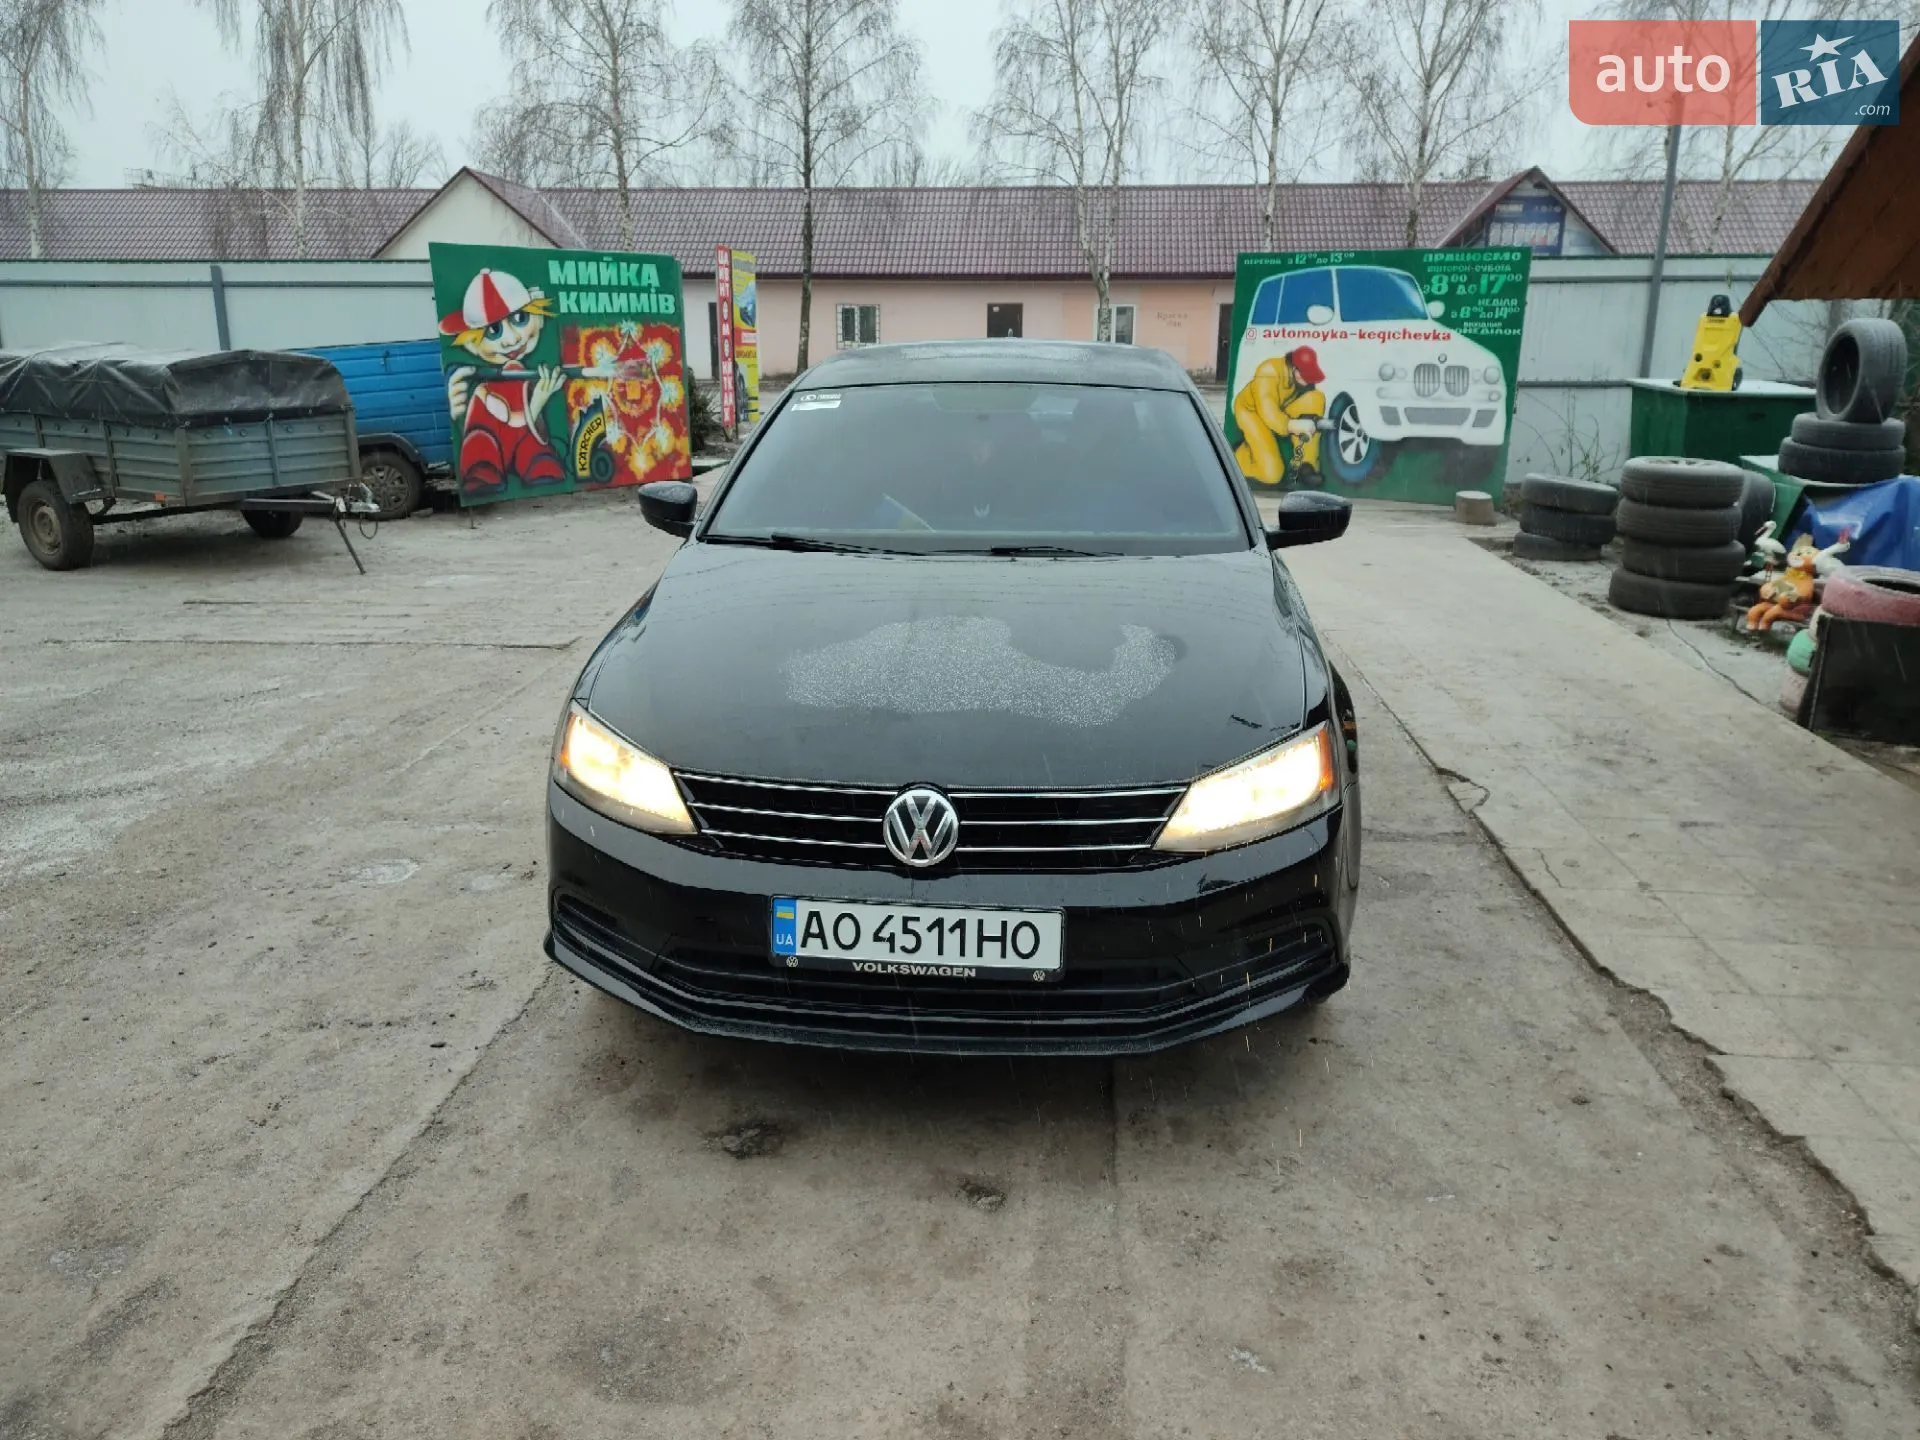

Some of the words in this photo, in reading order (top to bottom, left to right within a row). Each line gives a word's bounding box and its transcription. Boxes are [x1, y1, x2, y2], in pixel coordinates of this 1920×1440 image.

[1423, 252, 1522, 263] ПРАЦЮЄМО
[548, 256, 660, 287] МИЙКА
[559, 288, 676, 315] КИЛИМІВ
[776, 933, 794, 946] UA
[852, 961, 977, 978] VOLKSWAGEN
